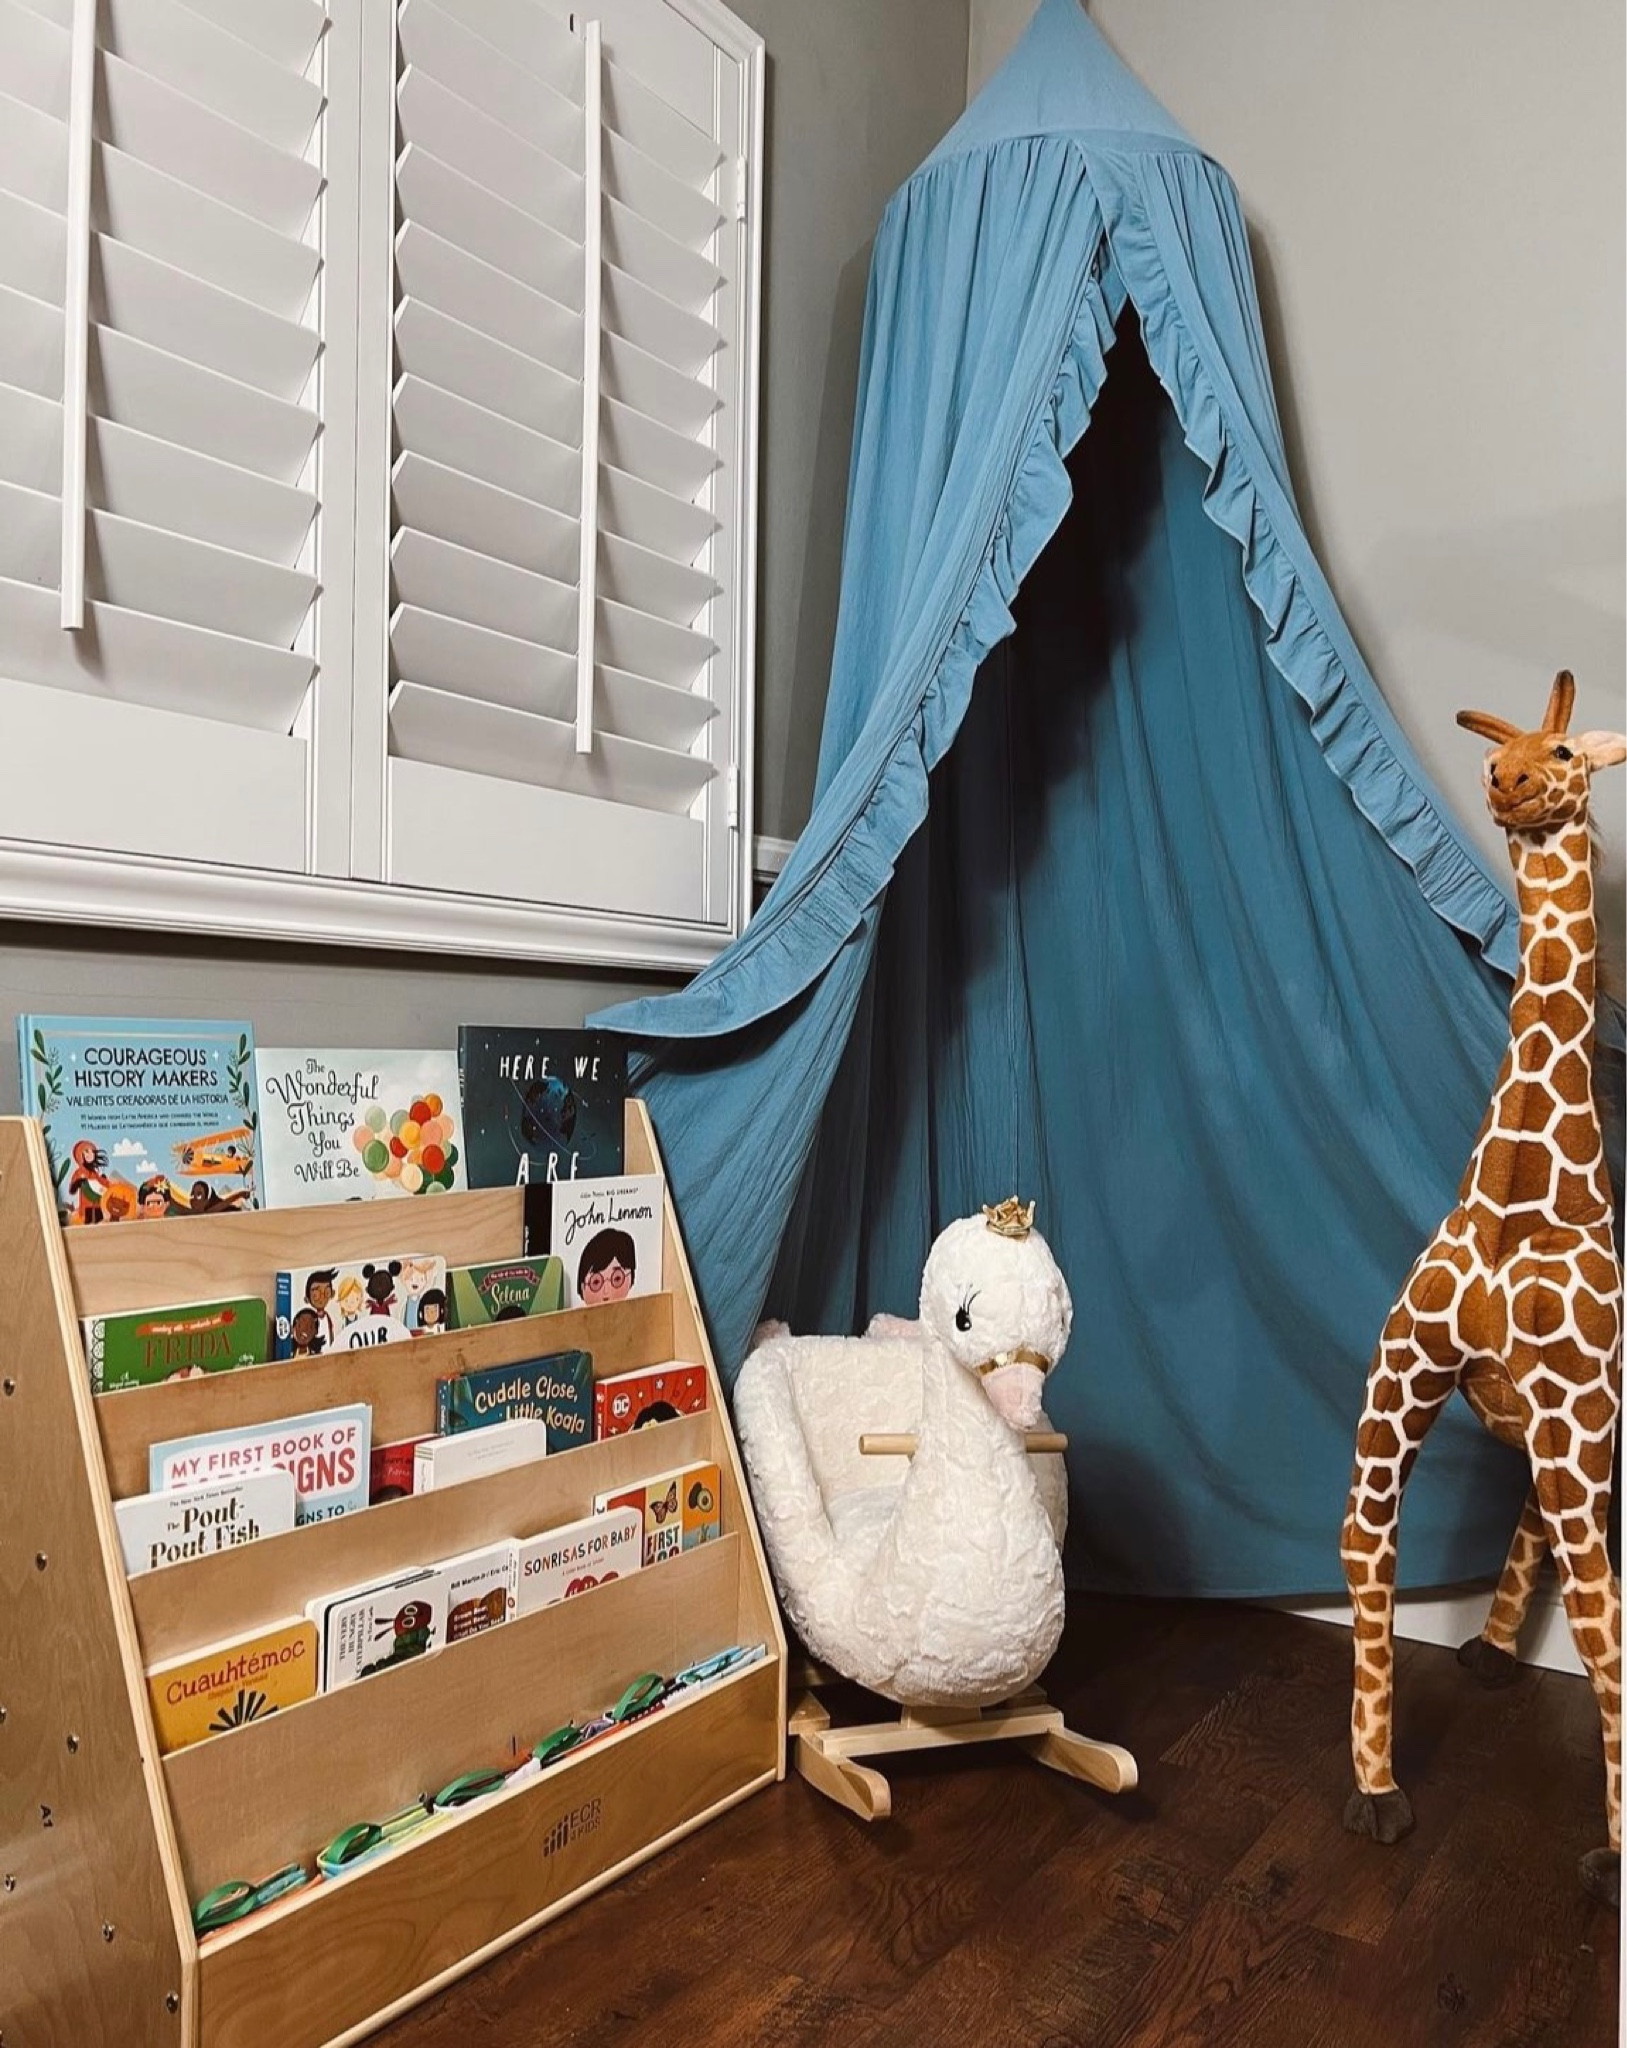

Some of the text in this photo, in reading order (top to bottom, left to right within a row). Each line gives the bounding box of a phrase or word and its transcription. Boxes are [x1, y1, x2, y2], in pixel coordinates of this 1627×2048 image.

[84, 1047, 207, 1066] COURAGEOUS
[306, 1058, 325, 1074] The
[499, 1055, 601, 1081] HERE WE
[74, 1070, 218, 1088] HISTORY MAKERS
[266, 1069, 379, 1105] Wonderful
[66, 1093, 229, 1107] VALIENTES CREADORAS DE LA HISTORIA
[287, 1101, 355, 1135] Things
[308, 1131, 341, 1158] You
[294, 1158, 360, 1183] Will Be
[516, 1151, 579, 1185] ARE
[606, 1188, 615, 1196] BIG
[564, 1200, 605, 1246] John
[608, 1197, 653, 1223] Lennon
[490, 1282, 530, 1315] Selena
[143, 1331, 233, 1368] FRIDA
[349, 1326, 388, 1349] OUR
[475, 1375, 578, 1414] Cuddle Close,
[613, 1397, 630, 1415] DC
[506, 1402, 543, 1422] Little
[546, 1407, 585, 1434] Koala
[171, 1457, 201, 1479] MY
[208, 1446, 265, 1471] FIRST
[271, 1432, 325, 1459] BOOK
[331, 1427, 356, 1445] OF
[167, 1498, 245, 1533] The Pout-
[328, 1504, 345, 1518] TO
[149, 1519, 260, 1568] Pout Fish
[523, 1540, 586, 1577] SONRISAS
[587, 1533, 608, 1555] FOR
[610, 1522, 637, 1547] BABY
[646, 1526, 680, 1556] FIRST
[450, 1581, 460, 1590] Bill
[462, 1575, 480, 1586] Martin
[490, 1568, 500, 1576] Eric
[348, 1613, 357, 1653] HUNGRY
[355, 1608, 365, 1674] CATERPILLAR
[166, 1640, 306, 1705] Cuauhtémoc
[40, 1804, 53, 1828] A1
[570, 1798, 601, 1828] ECR
